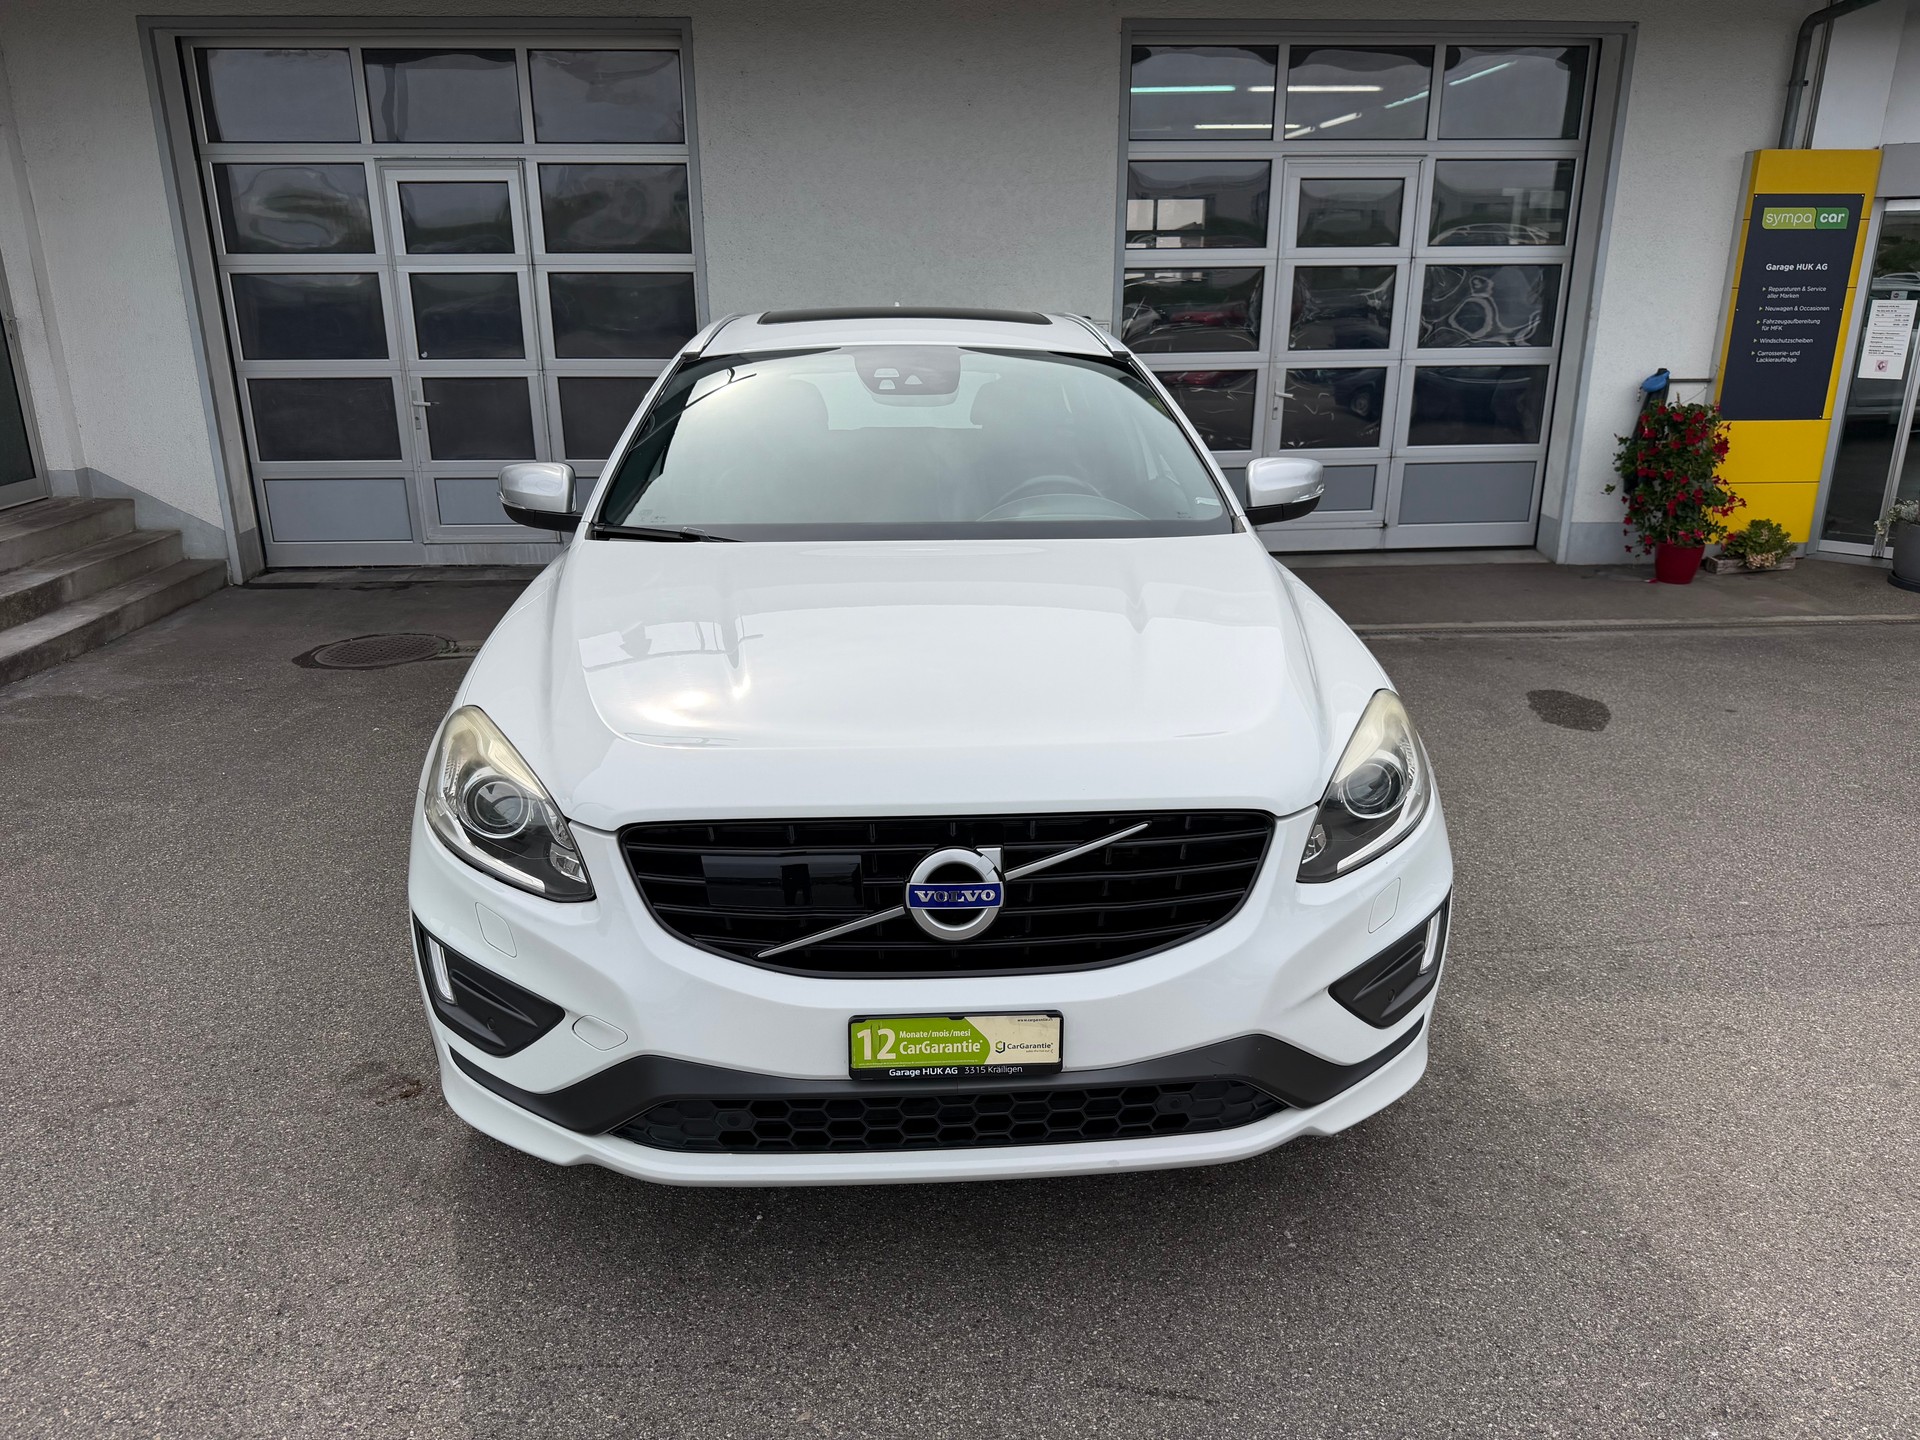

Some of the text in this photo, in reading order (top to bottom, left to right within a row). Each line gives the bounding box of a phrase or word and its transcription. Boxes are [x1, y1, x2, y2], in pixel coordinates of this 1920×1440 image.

[1765, 212, 1845, 226] sympa car
[1765, 263, 1828, 272] Garage HUK AG
[914, 889, 996, 903] VOLVO
[900, 1029, 971, 1039] Monate/mois/mesi
[857, 1028, 897, 1060] 12
[900, 1040, 981, 1055] CarGarantie
[889, 1068, 920, 1077] Garage
[922, 1067, 943, 1075] HUK
[945, 1067, 958, 1075] AG
[964, 1066, 986, 1074] 3315
